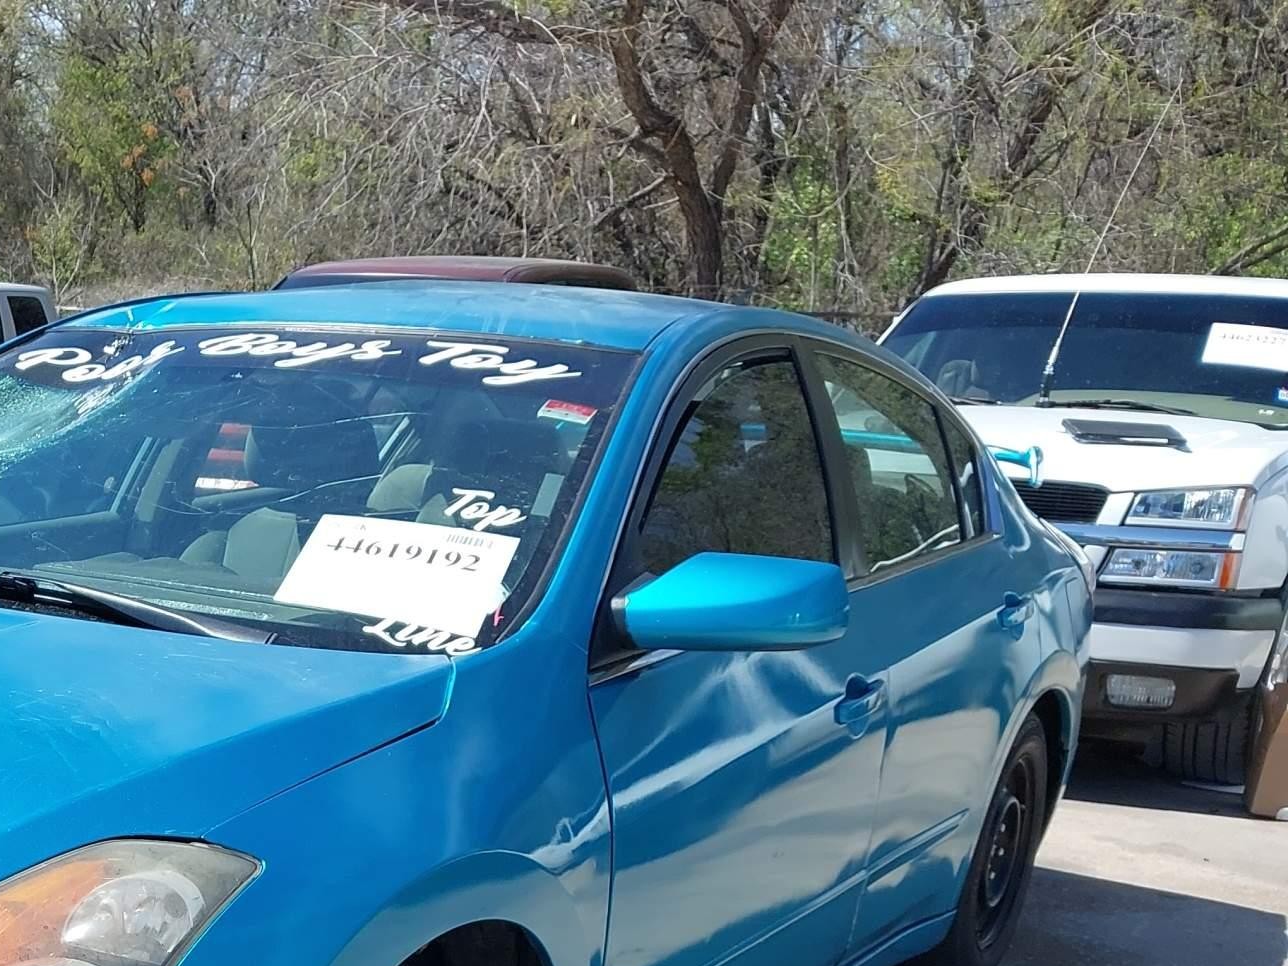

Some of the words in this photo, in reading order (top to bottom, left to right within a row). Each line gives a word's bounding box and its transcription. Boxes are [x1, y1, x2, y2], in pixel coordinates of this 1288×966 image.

[198, 333, 402, 368] Boys
[419, 340, 583, 386] Toy
[443, 487, 528, 532] Top
[326, 535, 482, 573] 44619192
